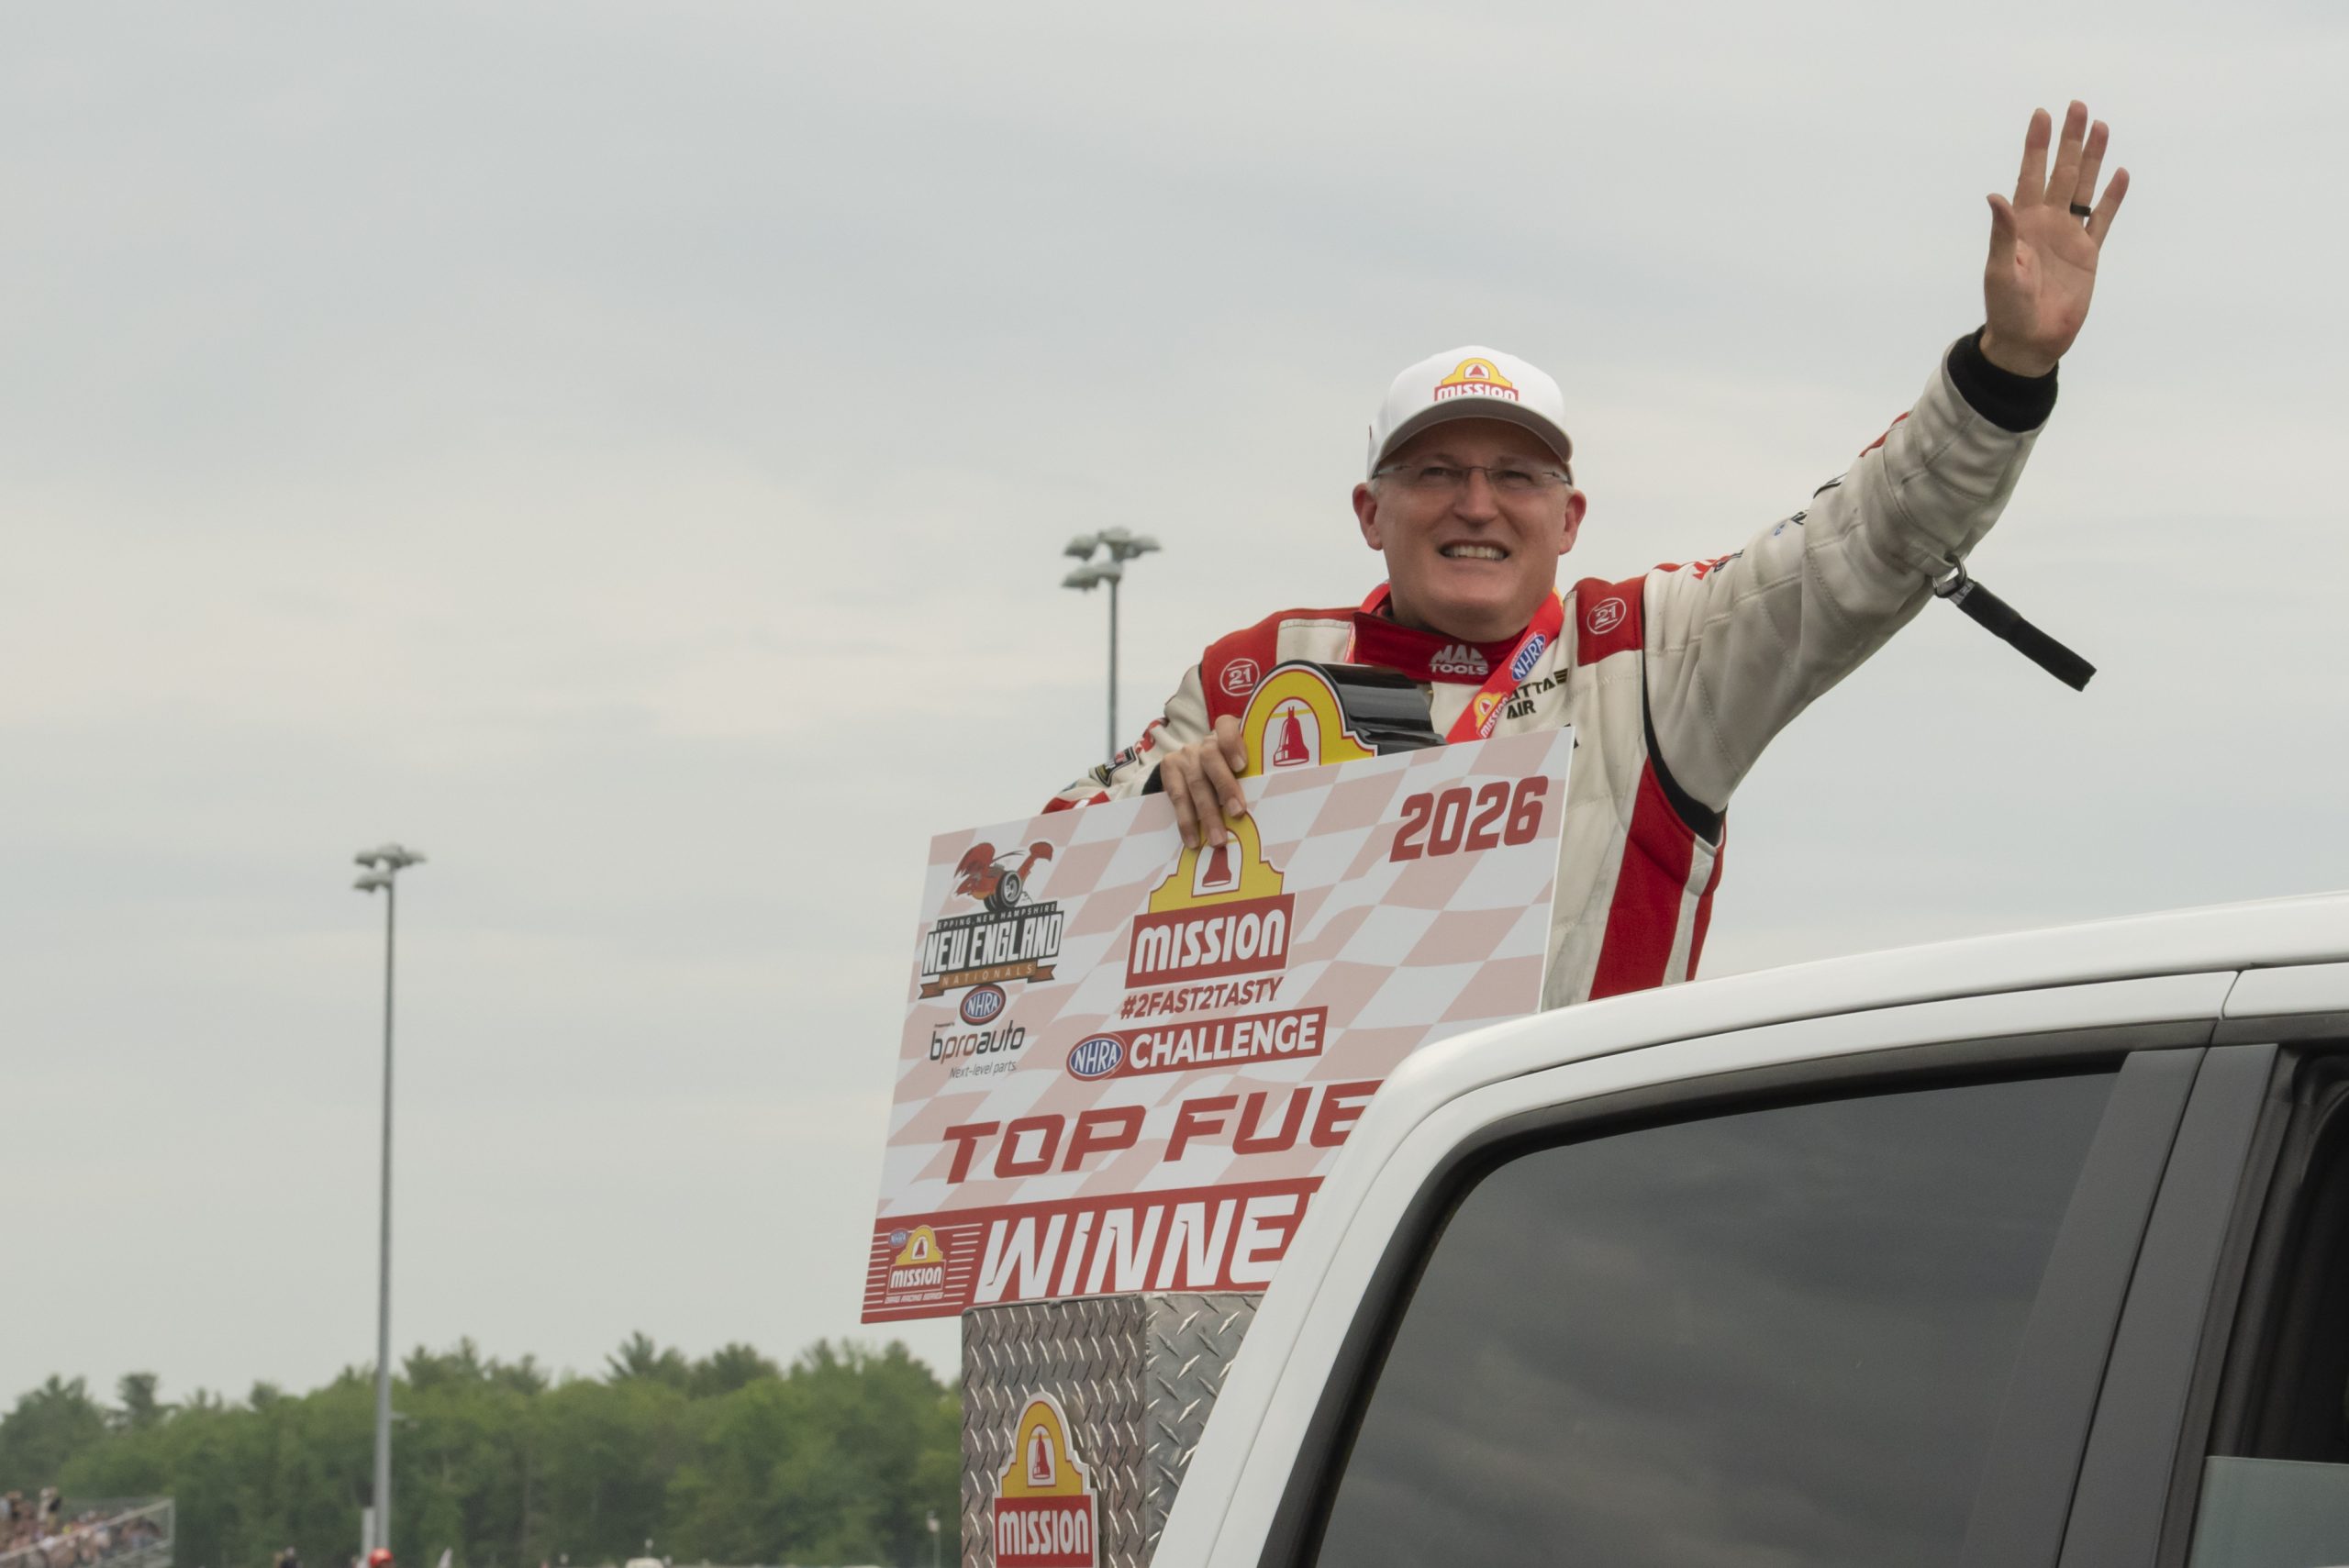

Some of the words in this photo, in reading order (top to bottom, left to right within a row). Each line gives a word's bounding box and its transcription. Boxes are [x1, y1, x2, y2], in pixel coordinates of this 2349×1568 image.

[1429, 663, 1488, 675] TOOLS
[1513, 637, 1545, 679] NHRA
[1507, 700, 1536, 719] AIR
[1390, 776, 1549, 862] 2026
[977, 914, 995, 923] NEW
[1001, 906, 1055, 919] HAMPSHIRE
[923, 929, 970, 974] NEW
[969, 914, 1063, 967] ENGLAND
[1132, 909, 1286, 973] MISSION
[941, 965, 1032, 985] NATIONALS
[967, 993, 999, 1017] NHRA
[1120, 977, 1284, 1019] #2FAST2TASTY
[930, 1020, 1026, 1064] bproauto
[1074, 1040, 1118, 1074] NHRA
[1130, 1013, 1319, 1070] CHALLENGE
[950, 1062, 992, 1079] Next-level
[942, 1105, 1147, 1184] TOP
[1163, 1079, 1385, 1162] FUE
[974, 1192, 1318, 1304] WINNE
[890, 1267, 943, 1289] MISSION
[998, 1508, 1089, 1556] MISSION
